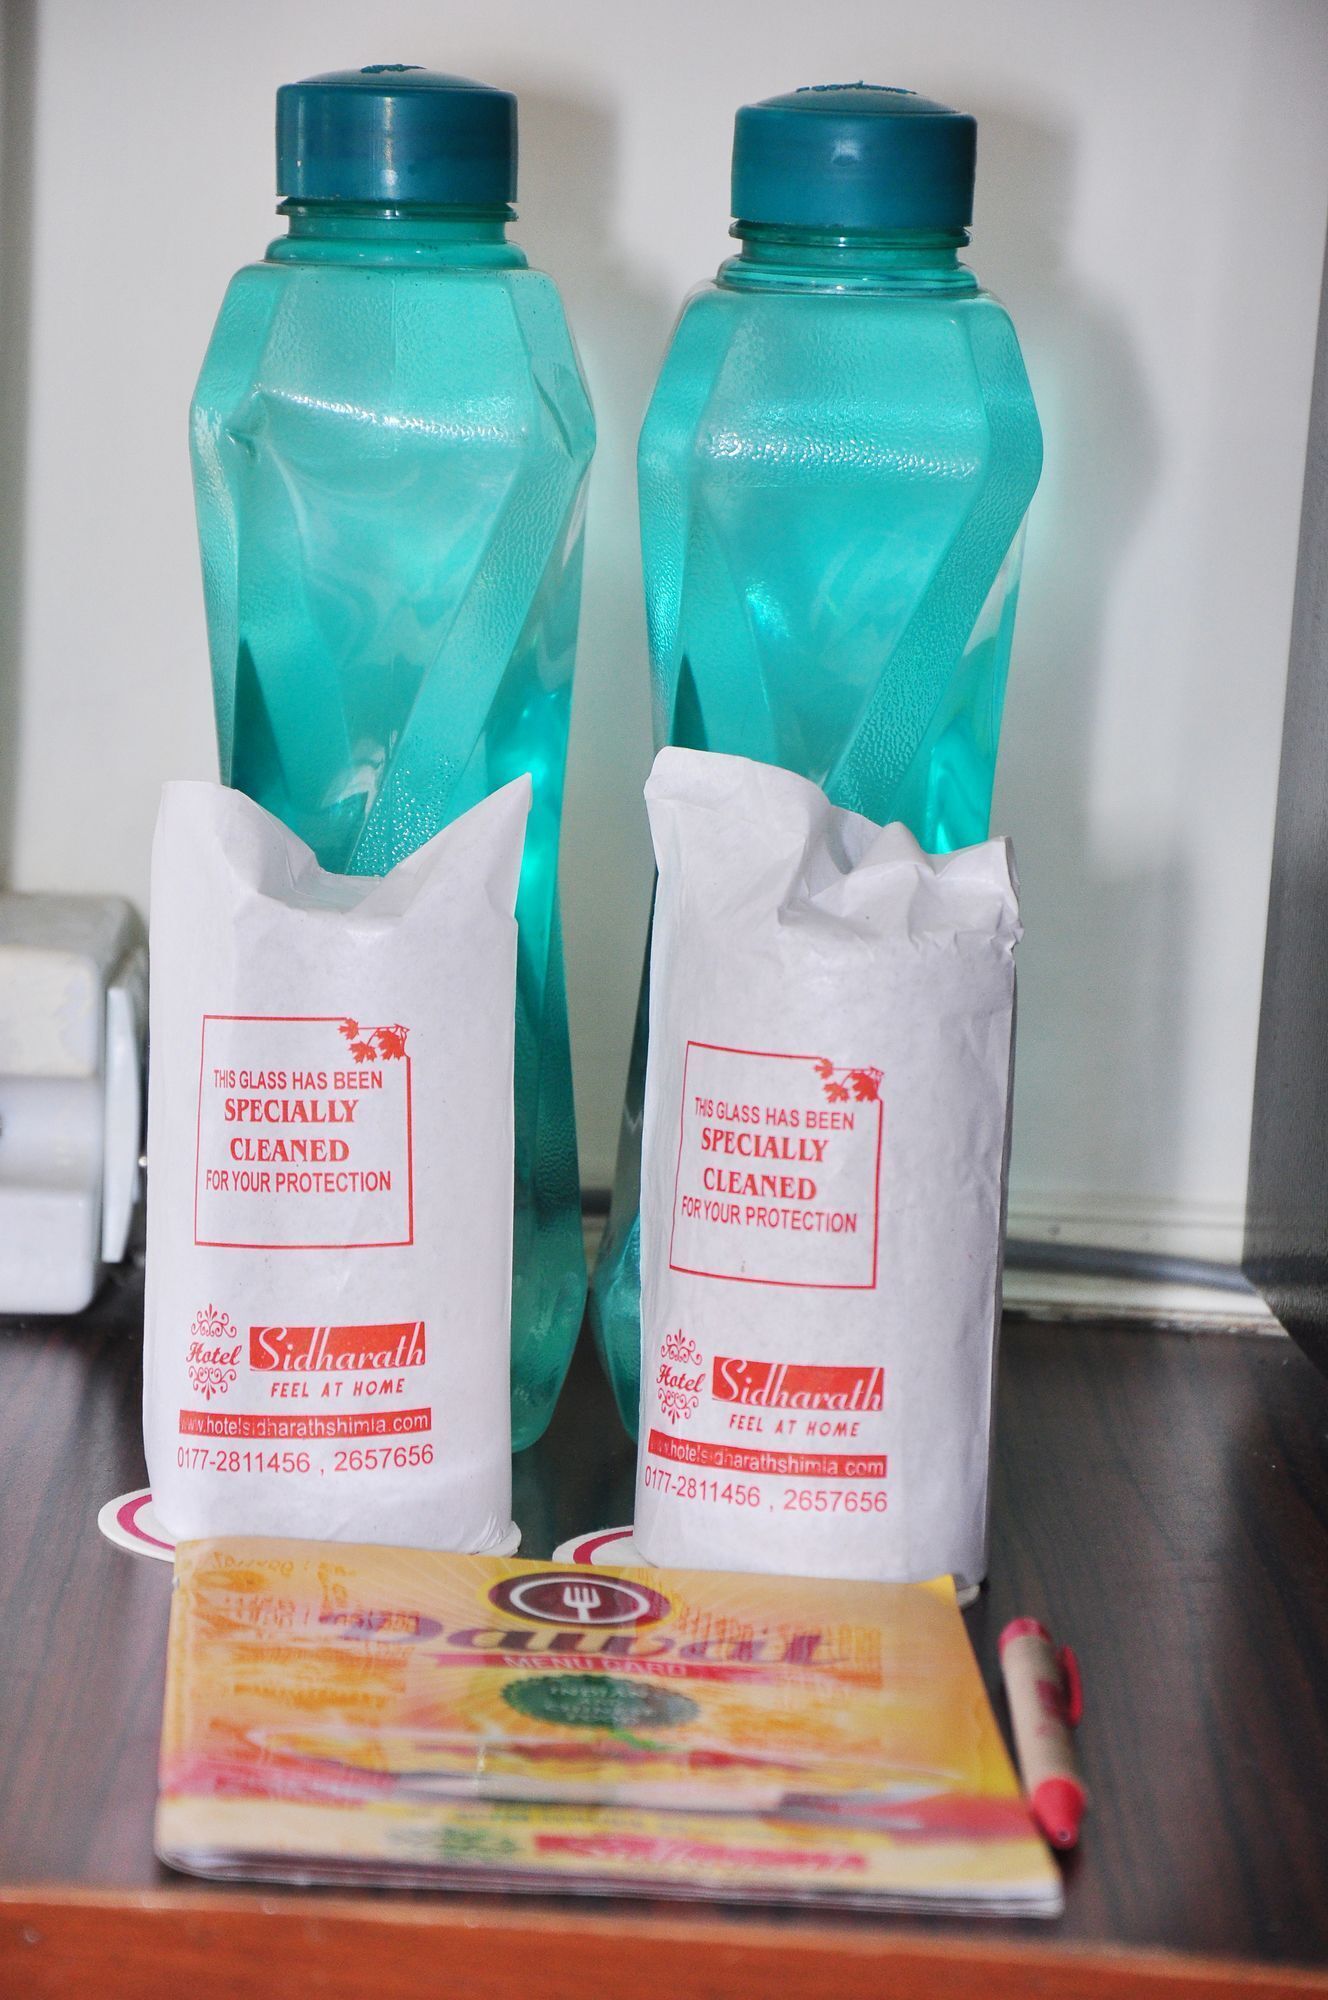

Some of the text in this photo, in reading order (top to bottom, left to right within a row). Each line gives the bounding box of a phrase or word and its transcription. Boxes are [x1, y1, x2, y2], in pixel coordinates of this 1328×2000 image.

[213, 1070, 383, 1091] THIS GLASS HAS BEEN
[224, 1098, 359, 1124] SPECIALLY
[695, 1097, 855, 1131] THIS GLASS HAS BEEN
[229, 1137, 350, 1163] CLEANED
[701, 1127, 829, 1163] SPECIALLY
[206, 1170, 392, 1193] FOR YOUR PROTECTION
[703, 1167, 818, 1202] CLEANED
[682, 1195, 856, 1233] FOR YOUR PROTECTION
[185, 1321, 425, 1372] Hotel Sidharath
[271, 1378, 406, 1398] FEEL AT HOME
[656, 1359, 884, 1411] Hotel Sidharath
[729, 1414, 861, 1437] FEEL AT HOME
[177, 1446, 311, 1473] 0177-2811456
[334, 1444, 434, 1472] 2657656
[644, 1465, 761, 1508] 0177-2811456
[783, 1488, 888, 1513] 2657656
[503, 1655, 687, 1677] MENU CARD
